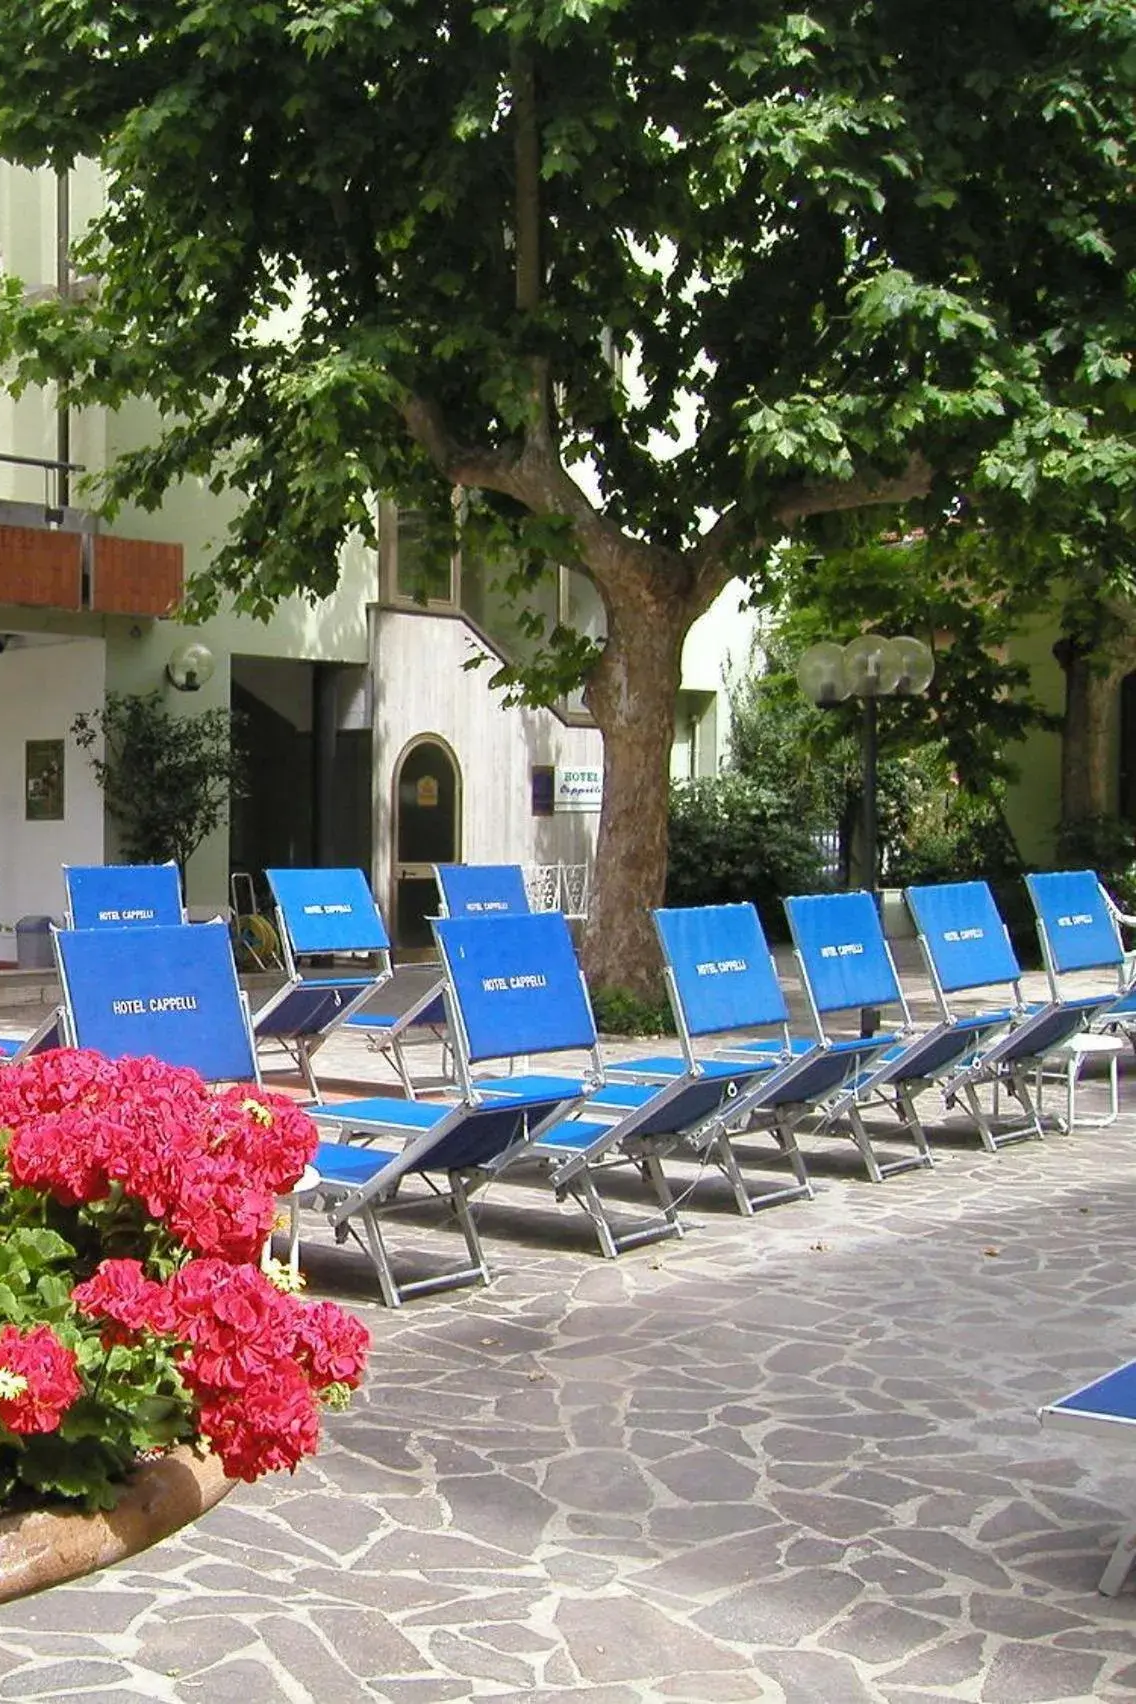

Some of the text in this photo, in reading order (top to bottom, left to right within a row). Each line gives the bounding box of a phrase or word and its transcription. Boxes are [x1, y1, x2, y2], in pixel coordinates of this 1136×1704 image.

[564, 772, 598, 782] HOTEL
[99, 910, 154, 921] HOTEL CAPPELLI
[482, 974, 546, 992] HOTEL CAPPELLI
[113, 996, 197, 1015] HOTEL CAPPELLI
